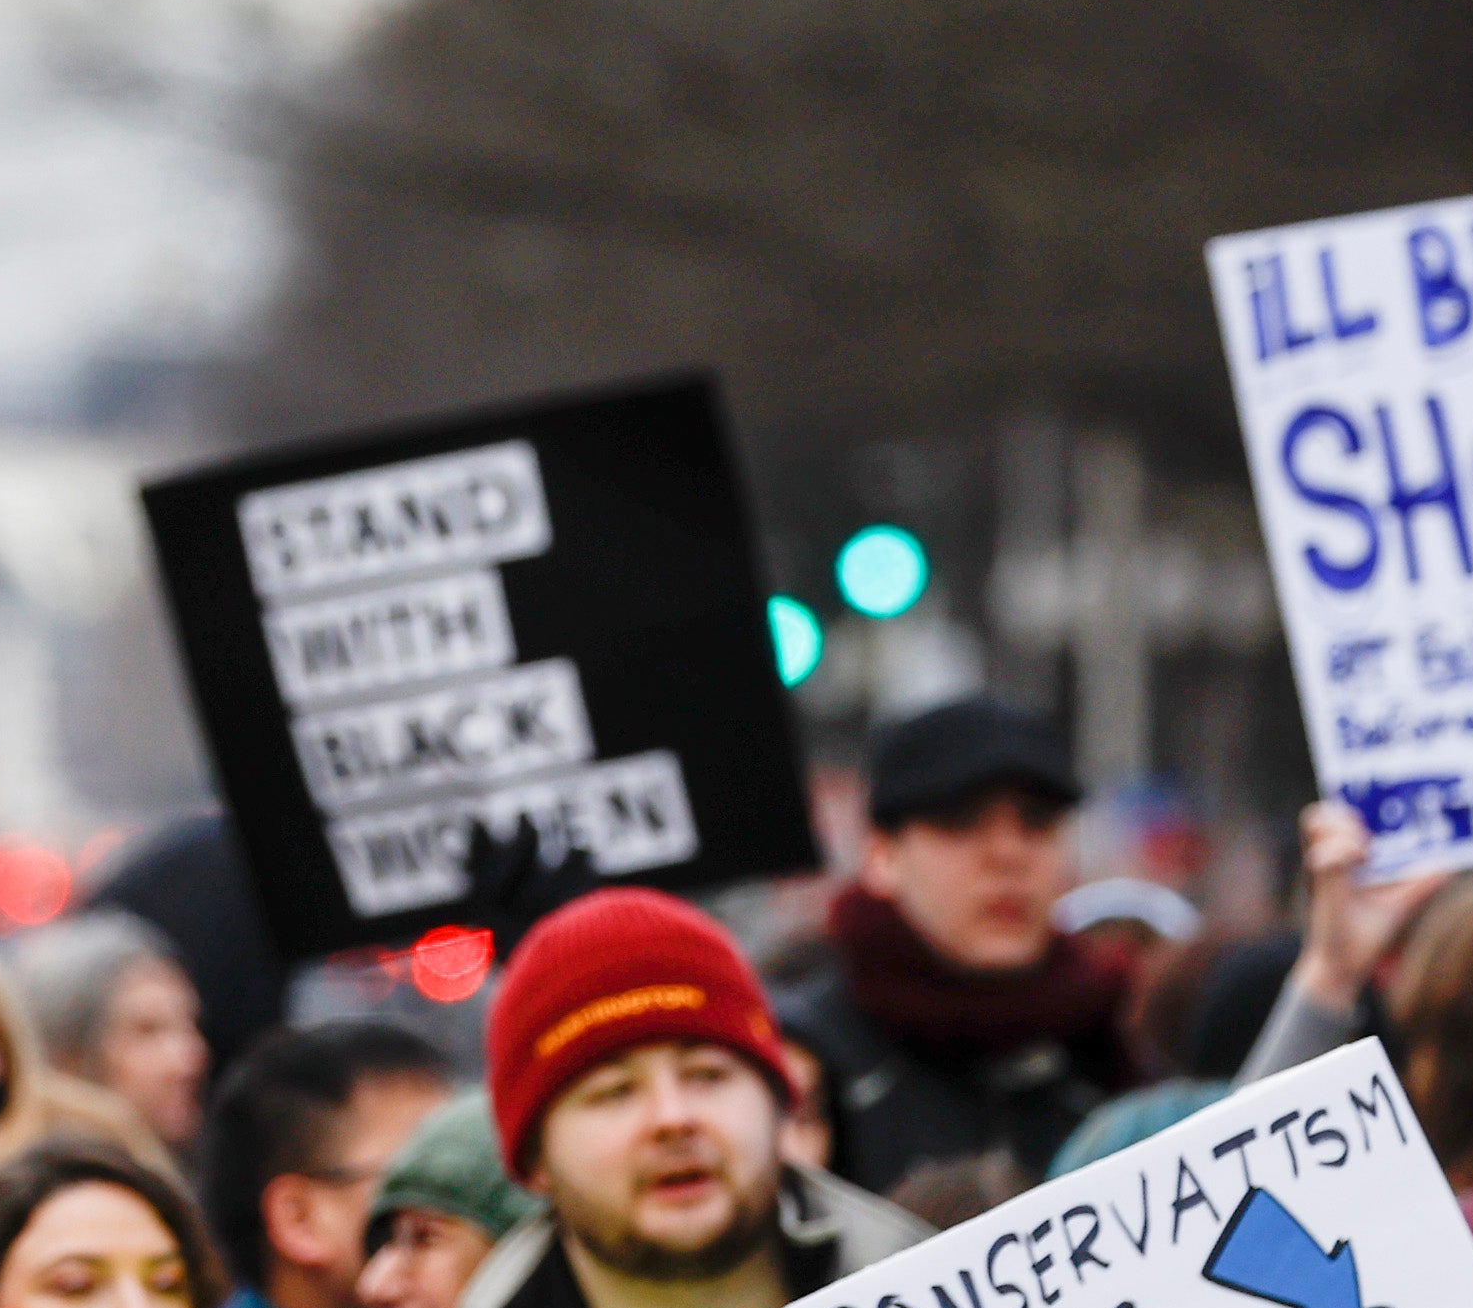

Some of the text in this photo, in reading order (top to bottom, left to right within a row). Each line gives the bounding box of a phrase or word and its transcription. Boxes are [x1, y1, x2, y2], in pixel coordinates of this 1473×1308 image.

[266, 474, 520, 577] STAND
[290, 602, 486, 682] WITH
[319, 689, 562, 787] BLACK
